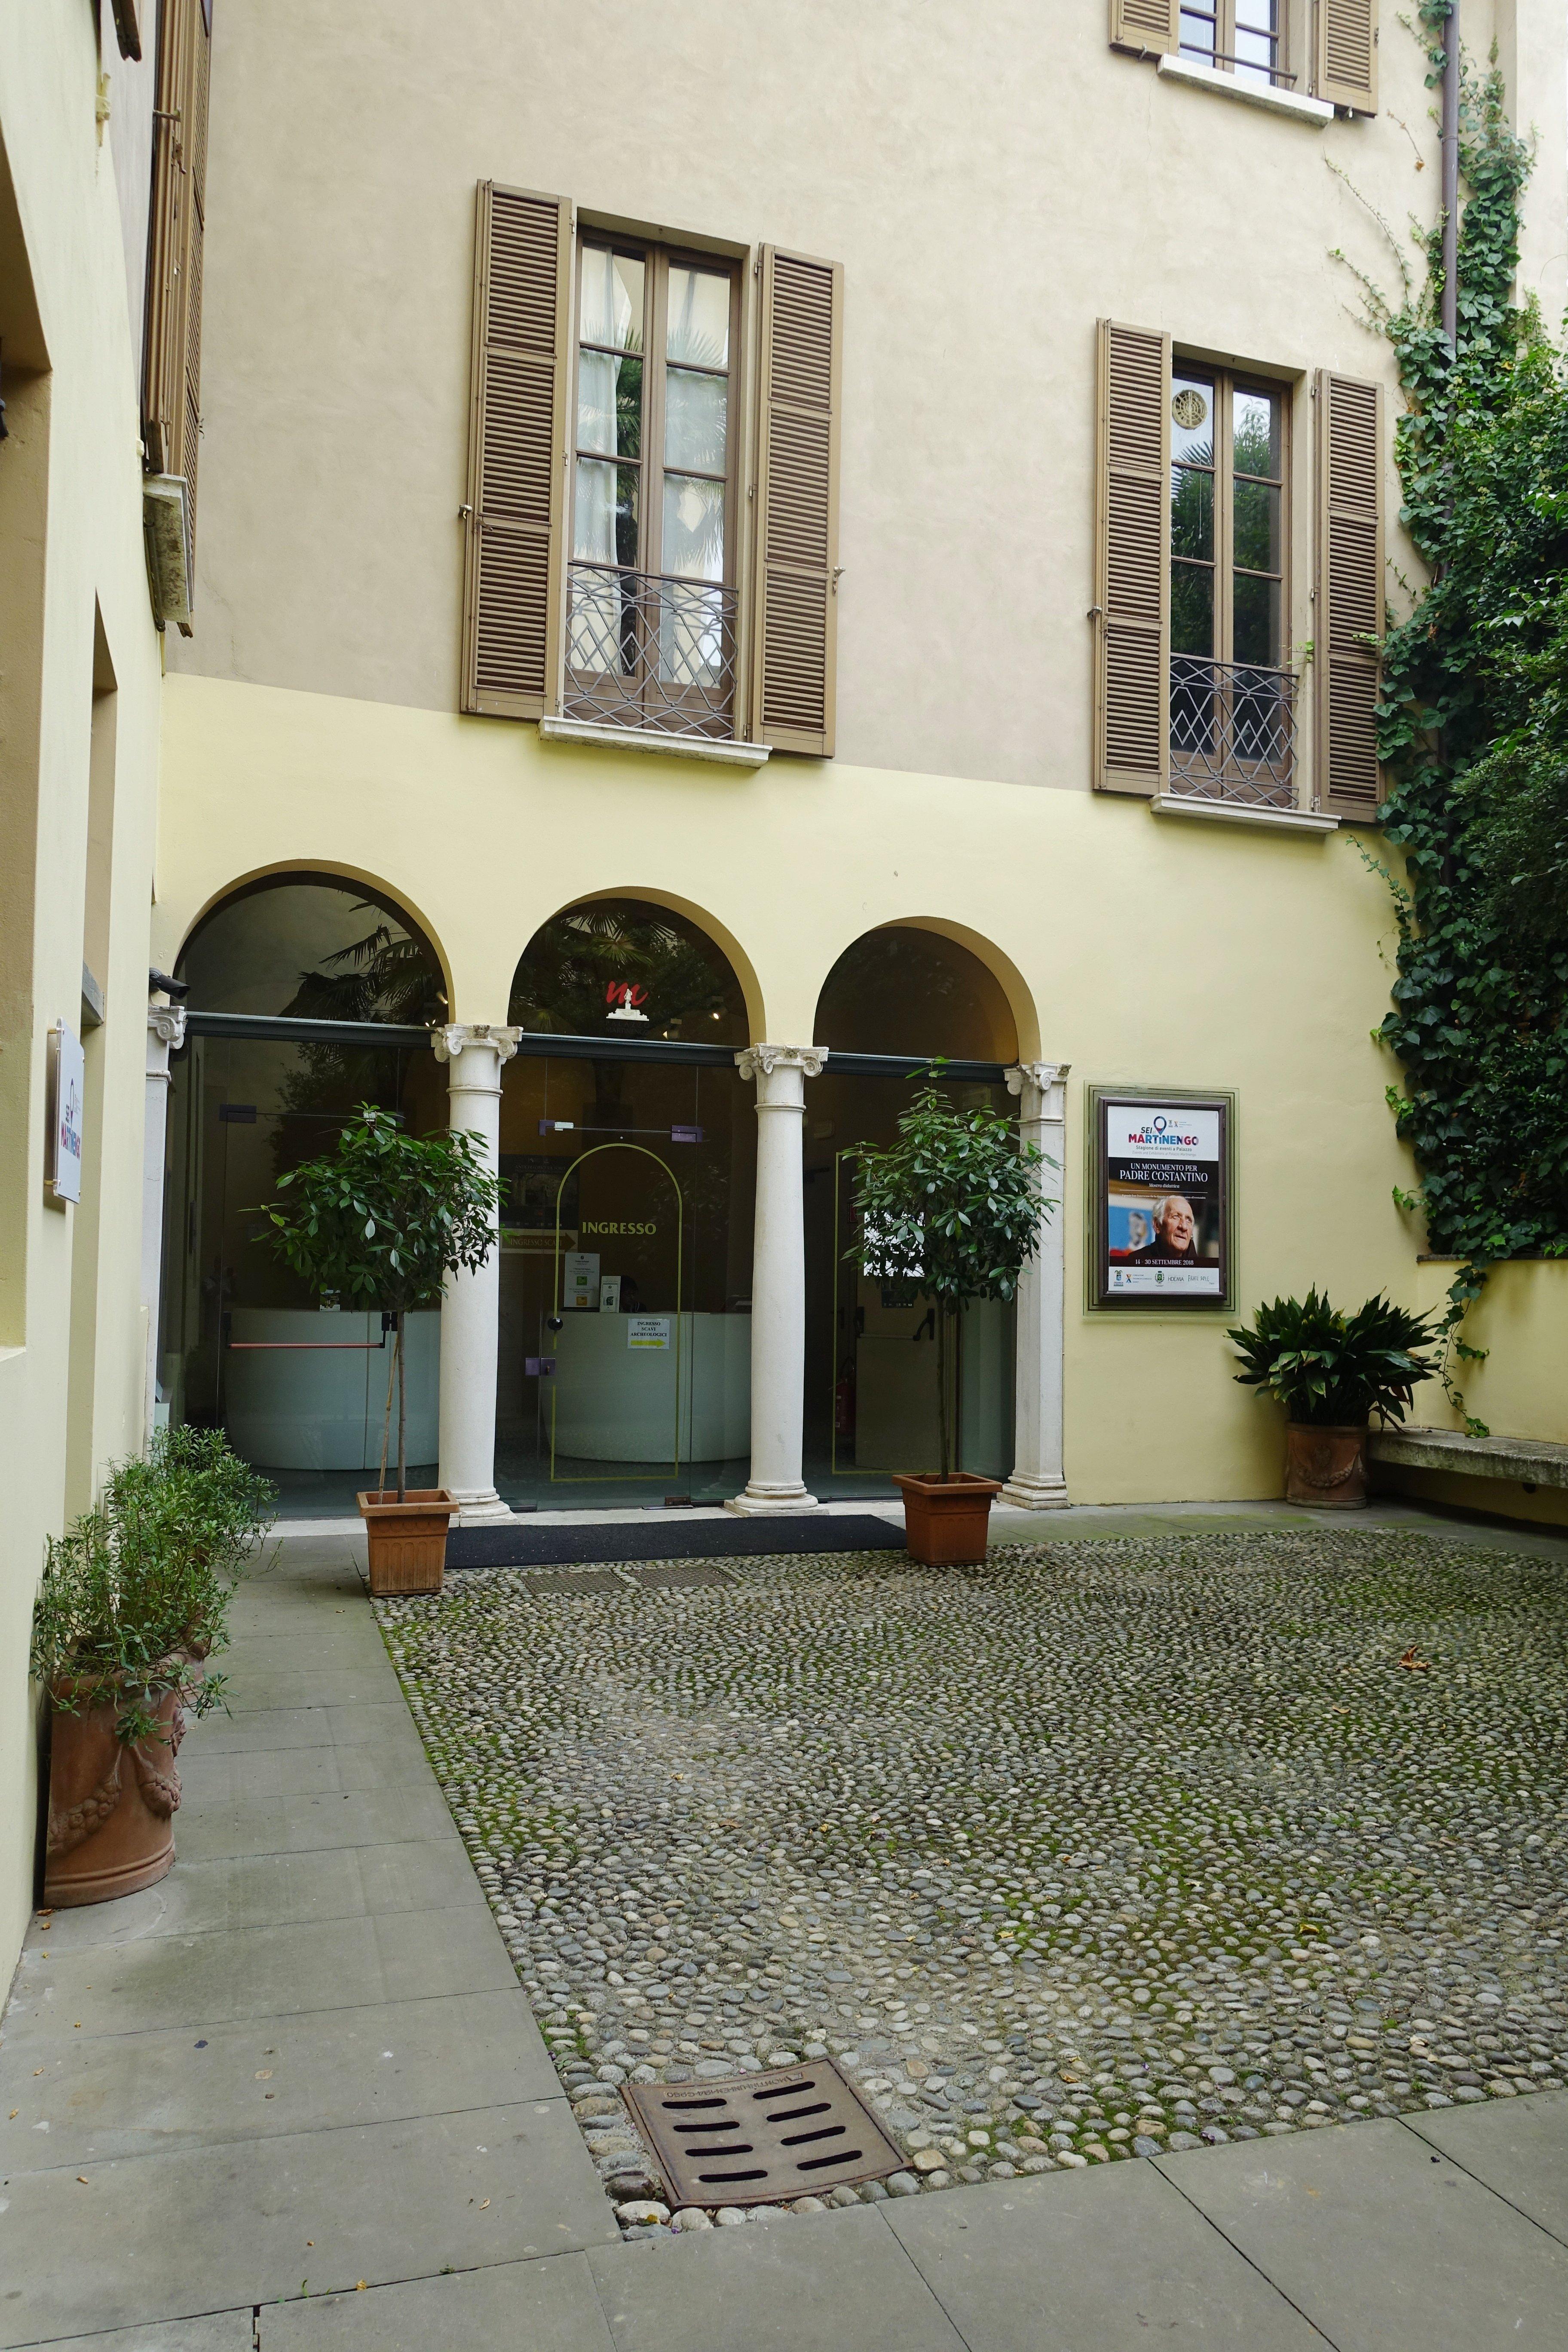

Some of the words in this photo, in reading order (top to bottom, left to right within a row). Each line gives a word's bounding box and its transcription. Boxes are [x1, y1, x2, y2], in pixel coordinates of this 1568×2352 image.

[1120, 1170, 1149, 1181] PADRE
[1152, 1171, 1208, 1182] COSTANTINO
[582, 1222, 657, 1235] INGRESSO
